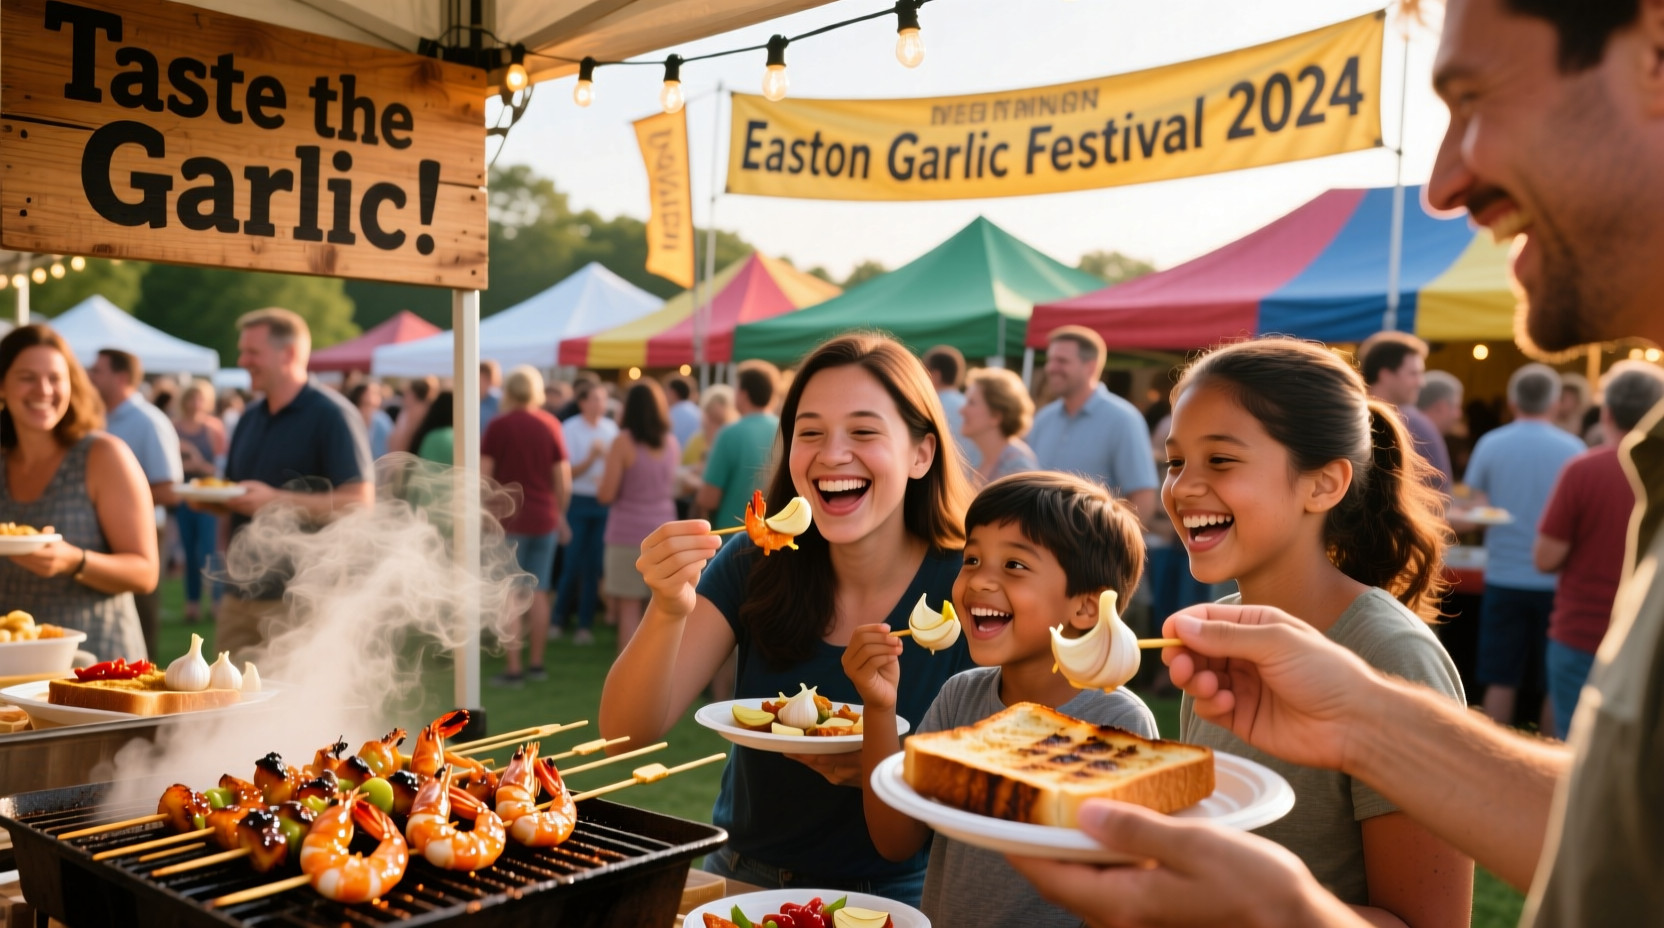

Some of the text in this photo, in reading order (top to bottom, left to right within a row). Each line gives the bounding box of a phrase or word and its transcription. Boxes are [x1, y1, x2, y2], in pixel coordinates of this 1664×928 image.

[44, 0, 414, 149] Taste the
[741, 119, 871, 180] Easton
[886, 131, 1010, 182] Garlic
[1025, 96, 1205, 175] Festival
[1226, 55, 1364, 141] 2024
[81, 119, 441, 256] Garlic!
